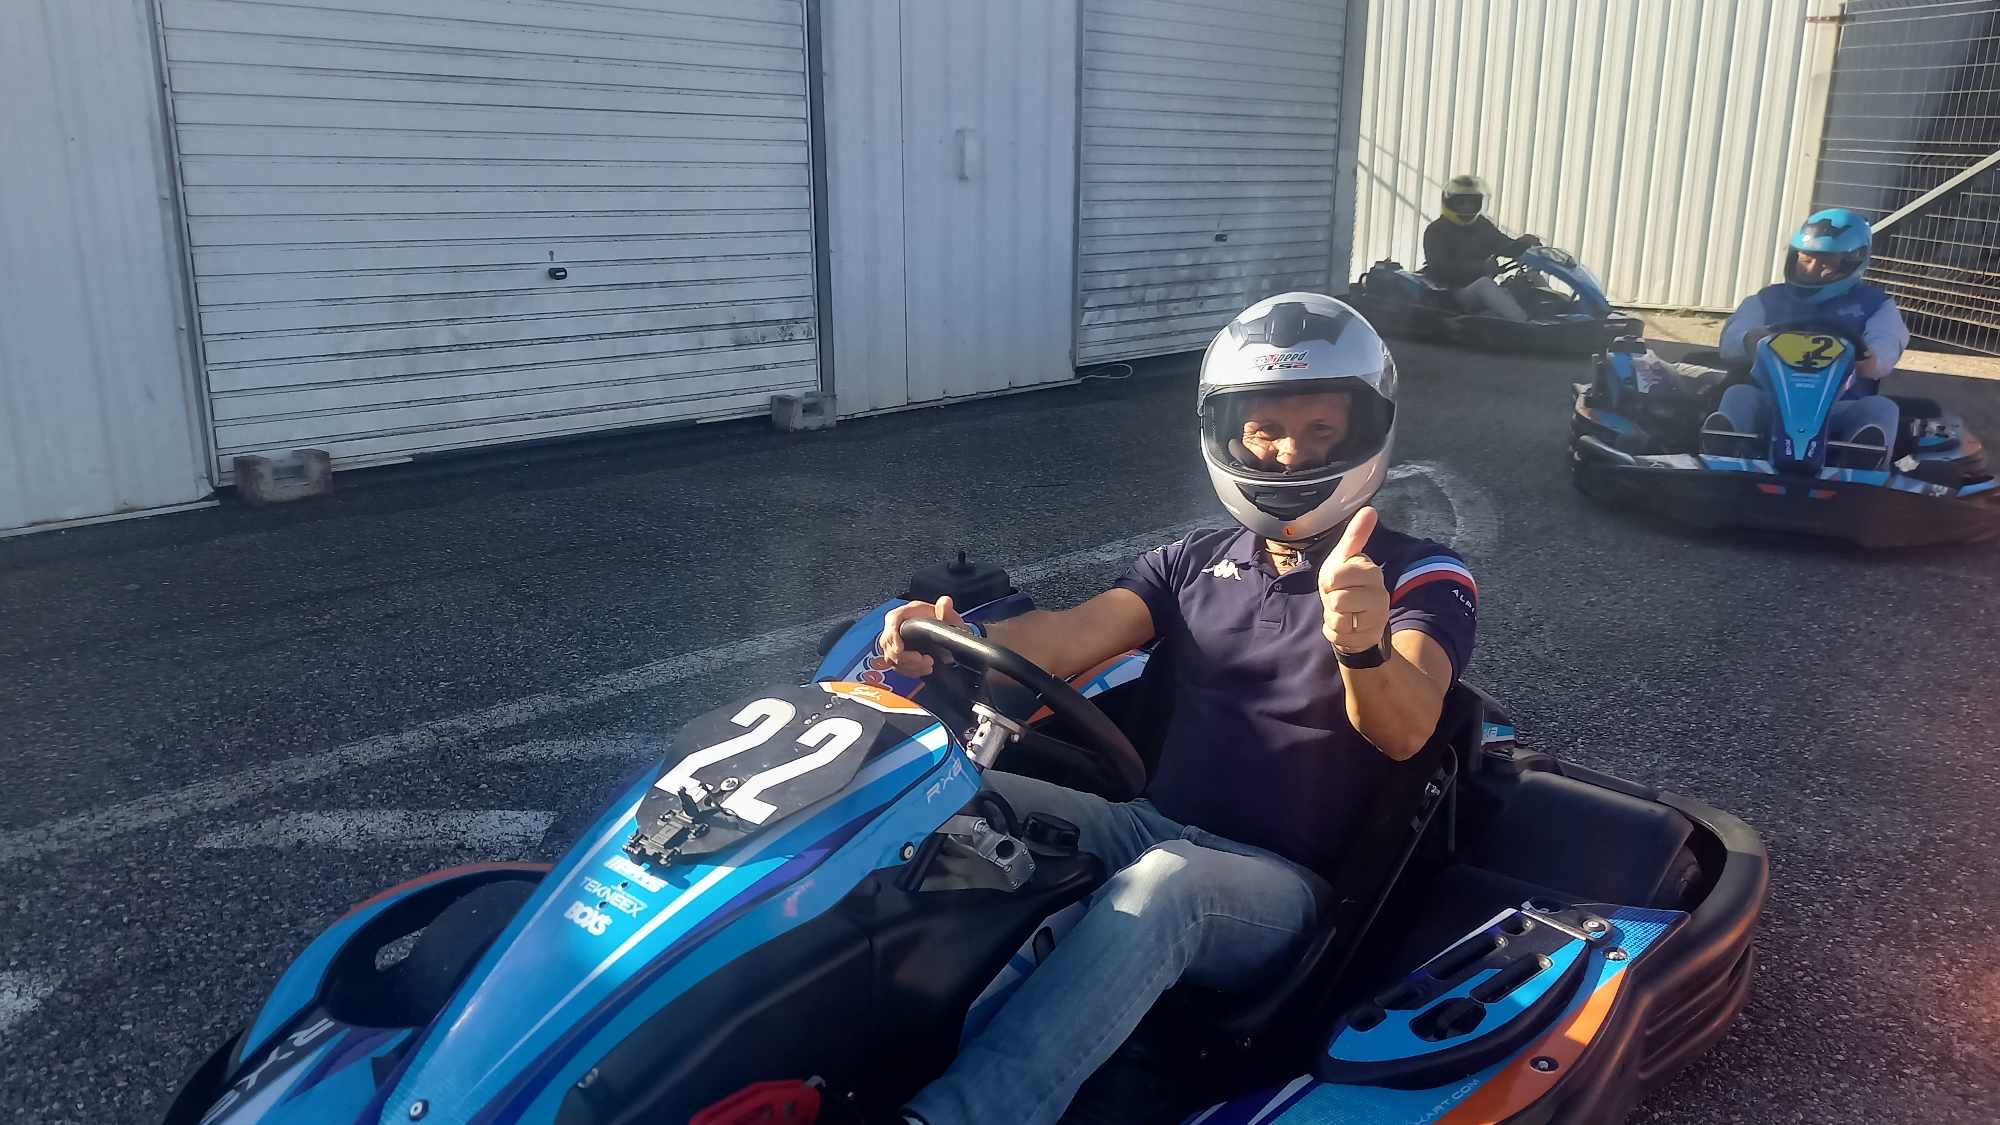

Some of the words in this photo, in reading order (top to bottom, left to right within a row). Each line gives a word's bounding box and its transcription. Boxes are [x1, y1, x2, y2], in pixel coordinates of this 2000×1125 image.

[1811, 335, 1834, 361] 2
[654, 697, 864, 825] 22
[579, 876, 648, 918] TEKNEEX
